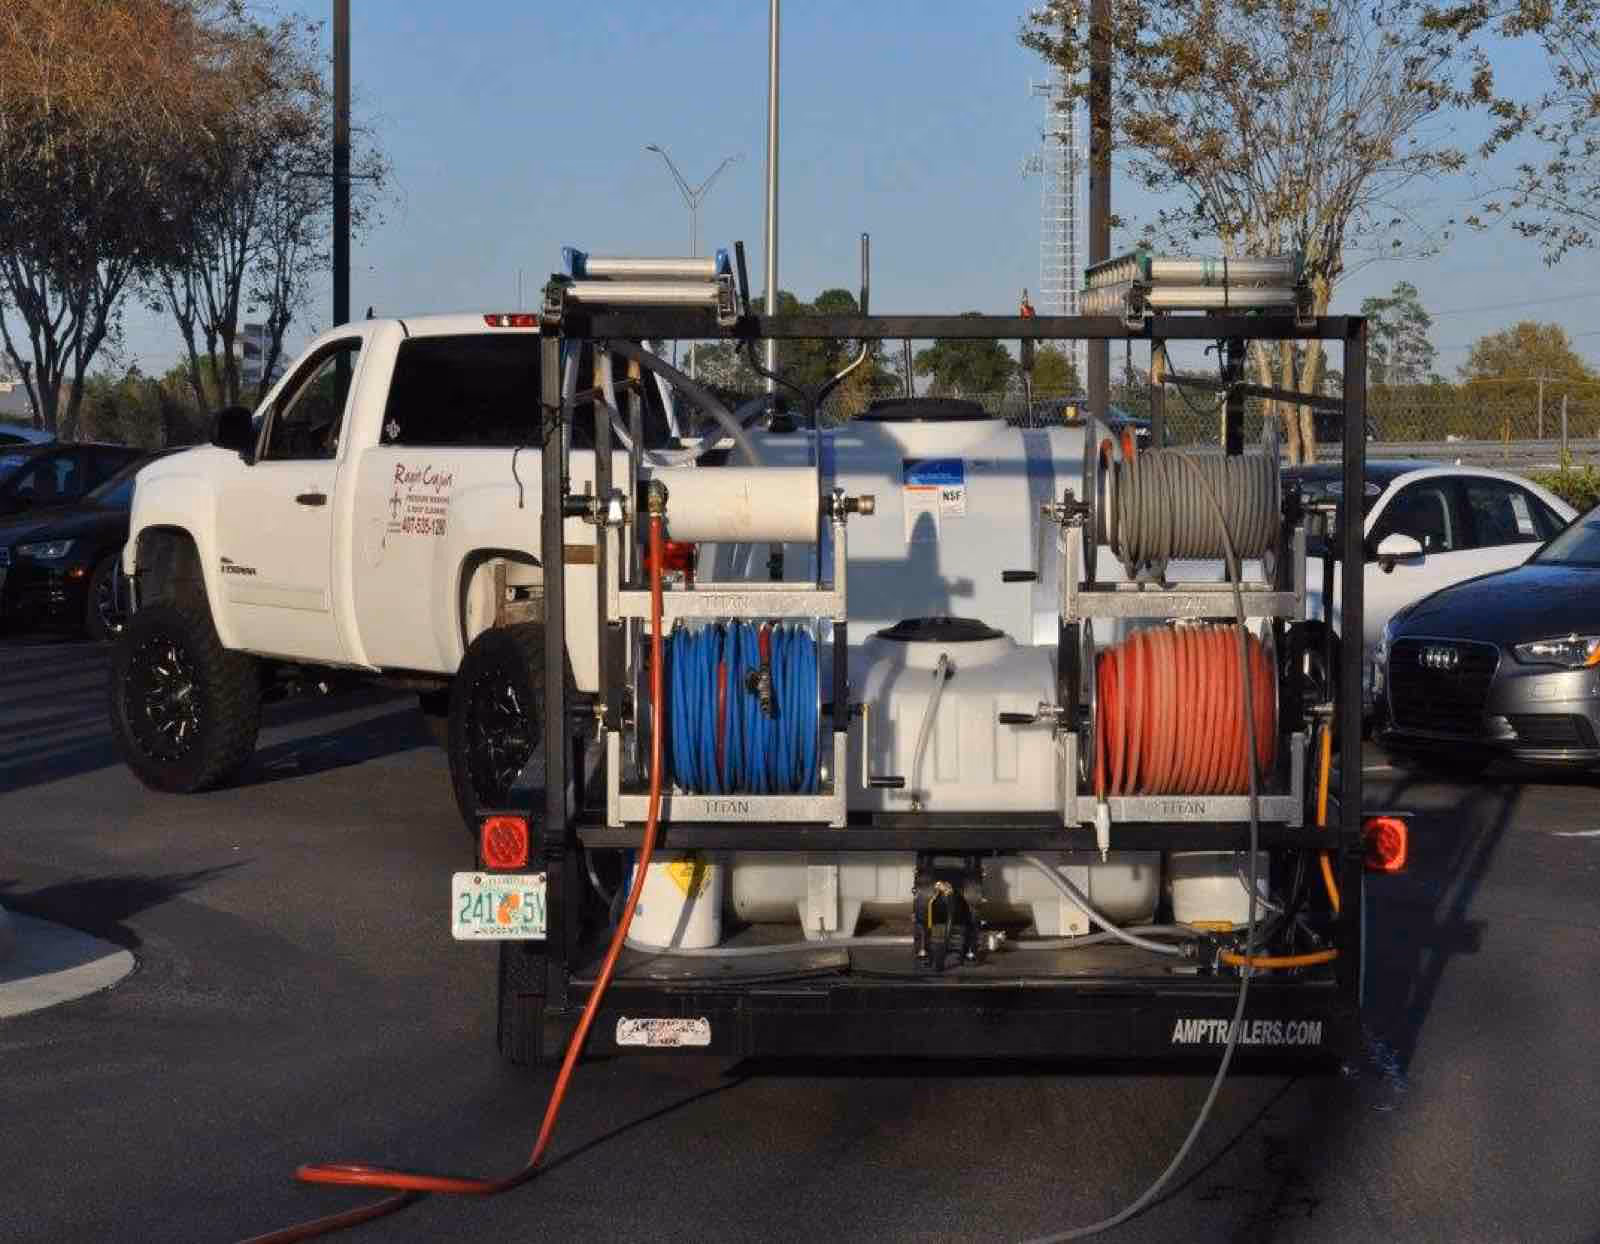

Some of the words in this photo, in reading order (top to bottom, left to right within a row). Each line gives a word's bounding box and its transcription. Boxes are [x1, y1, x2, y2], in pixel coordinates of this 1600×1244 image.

[943, 489, 961, 502] NSF
[705, 800, 750, 814] TITAN
[1160, 799, 1206, 814] TITAN
[460, 892, 495, 924] 241
[1171, 1018, 1323, 1045] AMPTRAILERS.COM
